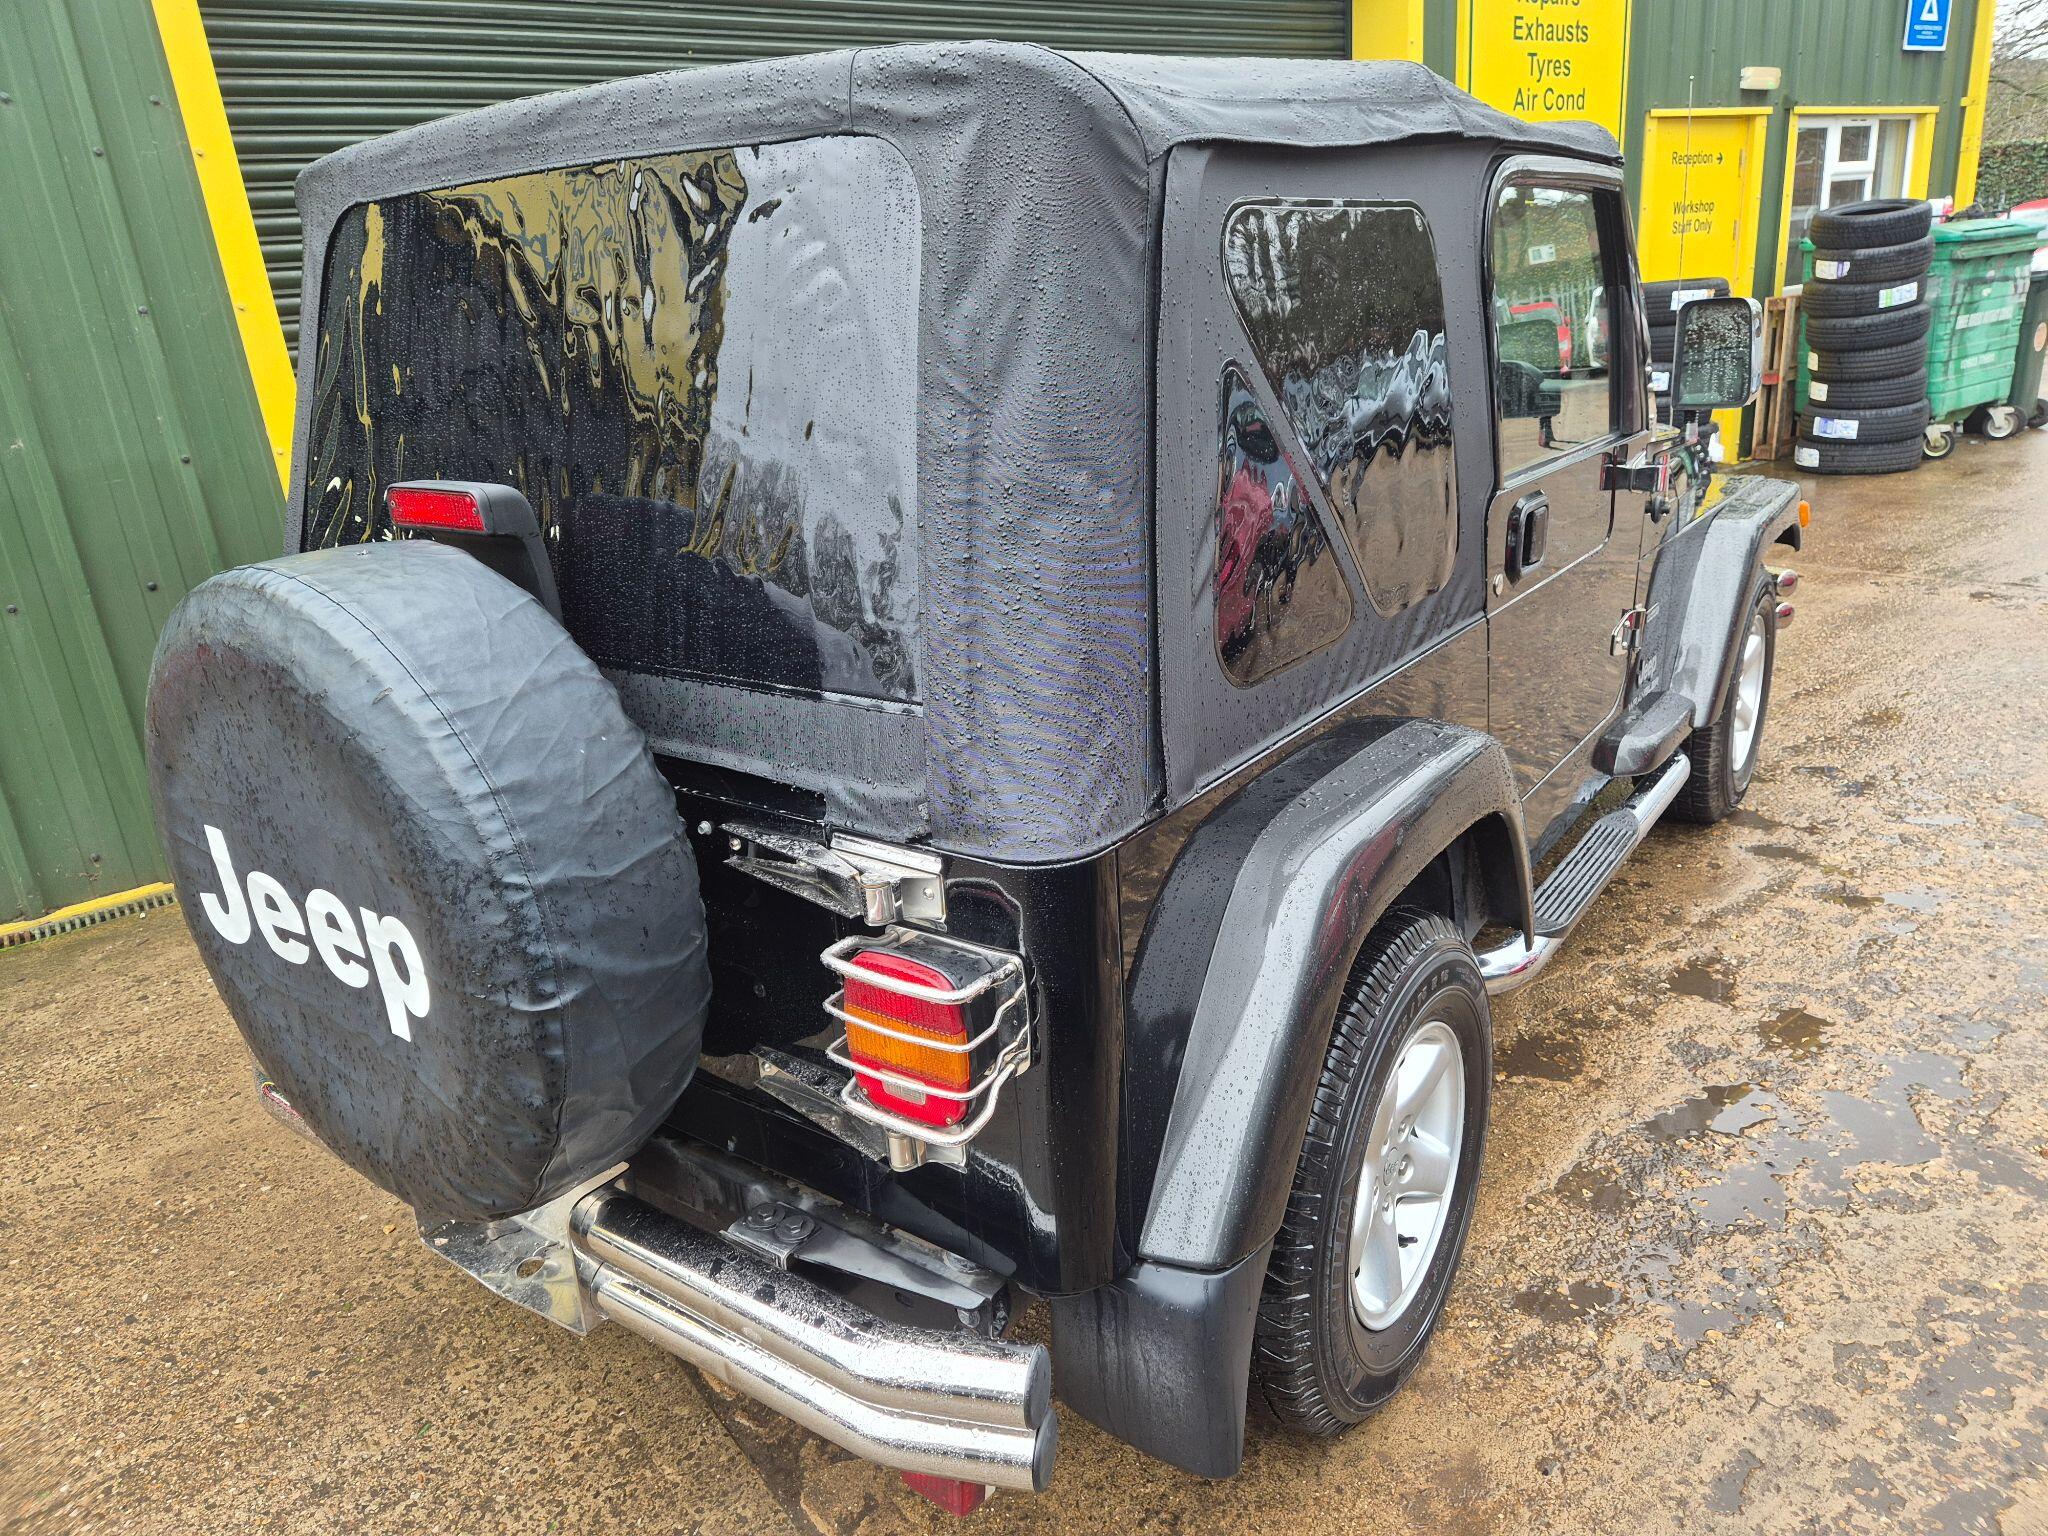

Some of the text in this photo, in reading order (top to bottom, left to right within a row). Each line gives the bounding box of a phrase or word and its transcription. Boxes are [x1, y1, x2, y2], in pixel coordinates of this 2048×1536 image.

[1513, 15, 1589, 43] Exhausts
[1527, 52, 1571, 83] Tyres
[1513, 87, 1586, 111] Air Cond
[1672, 151, 1714, 167] Reception
[1673, 200, 1715, 214] Workshop
[1672, 218, 1713, 235] Staff Only
[199, 824, 431, 1043] Jeep
